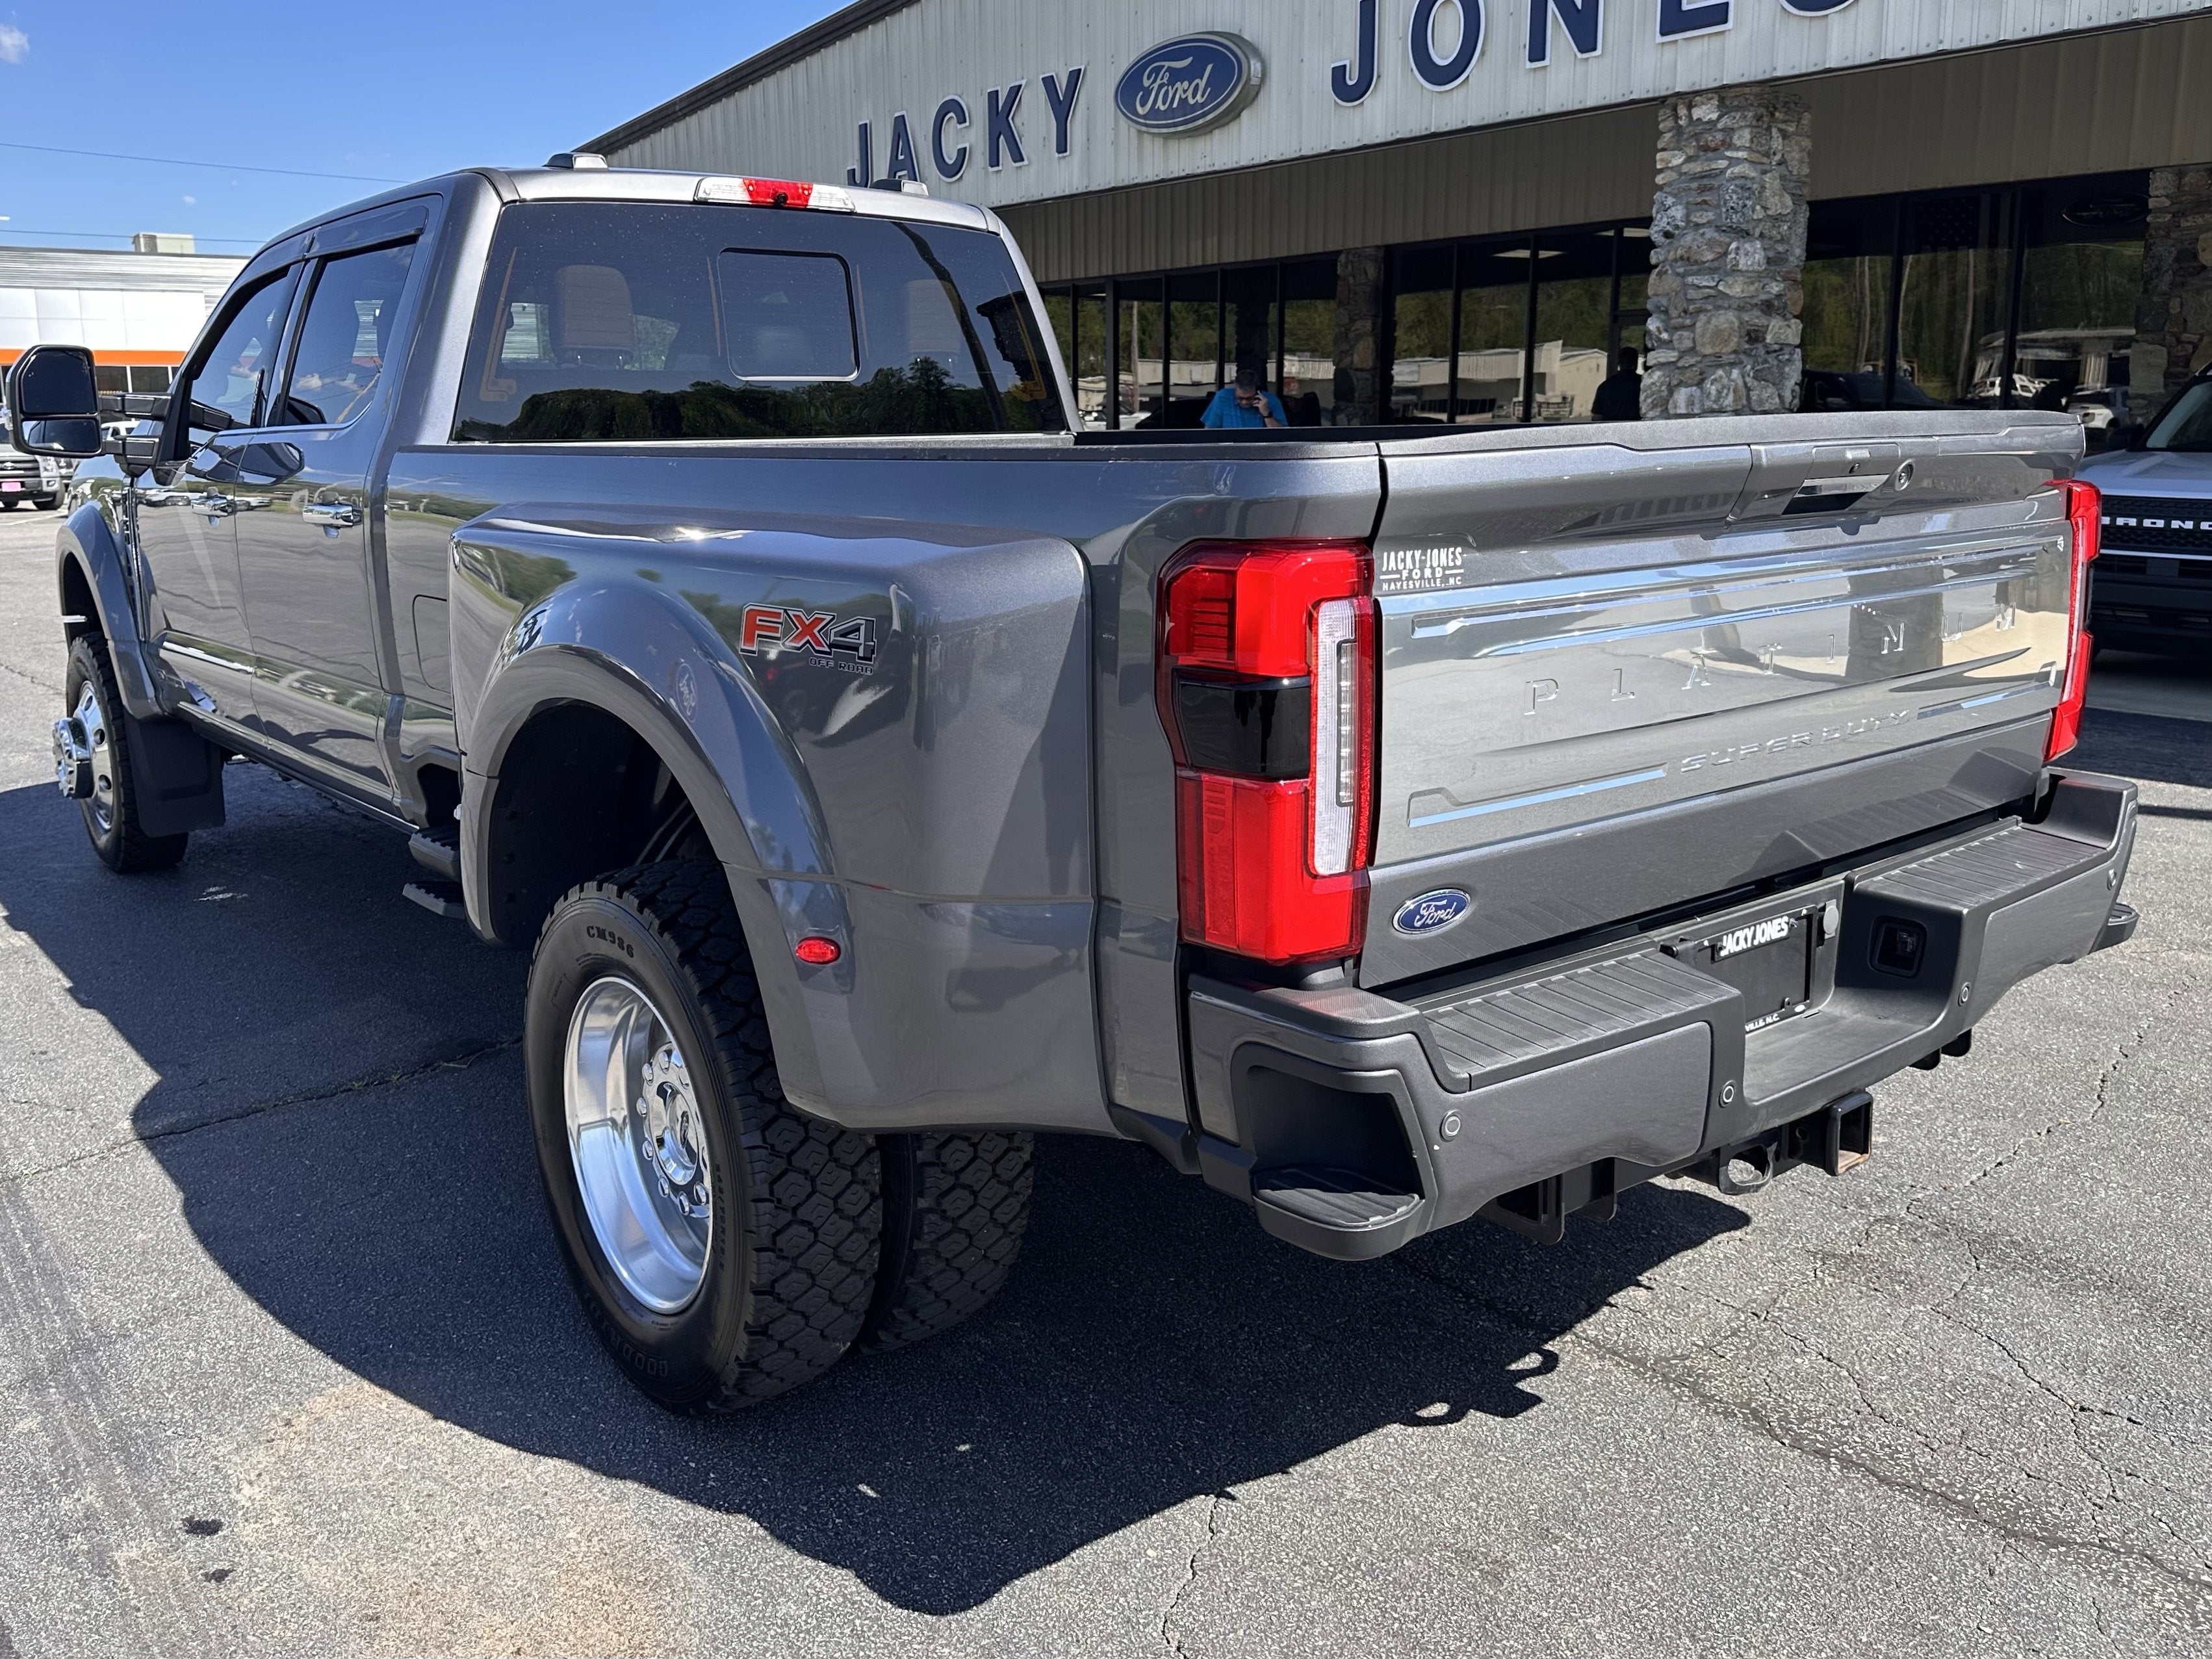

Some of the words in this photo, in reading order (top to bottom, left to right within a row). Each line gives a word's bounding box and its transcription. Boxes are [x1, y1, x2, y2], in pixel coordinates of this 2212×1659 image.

[847, 65, 1085, 188] JACKY
[1330, 0, 1854, 107] JON
[1136, 57, 1213, 116] Ford
[1382, 550, 1422, 572] JACKY
[1426, 547, 1462, 569] JONES
[1402, 567, 1443, 580] FORD
[739, 602, 877, 663] FX4
[809, 656, 834, 669] OFF
[838, 661, 873, 675] ROAD
[1524, 602, 2016, 716] PLATINUM
[1680, 732, 1814, 773] SUPER
[1821, 710, 1910, 742] DUTY
[1413, 899, 1458, 928] Ford
[586, 925, 635, 958] CM986
[1720, 925, 1755, 957] JACKY
[1753, 916, 1789, 946] JONES
